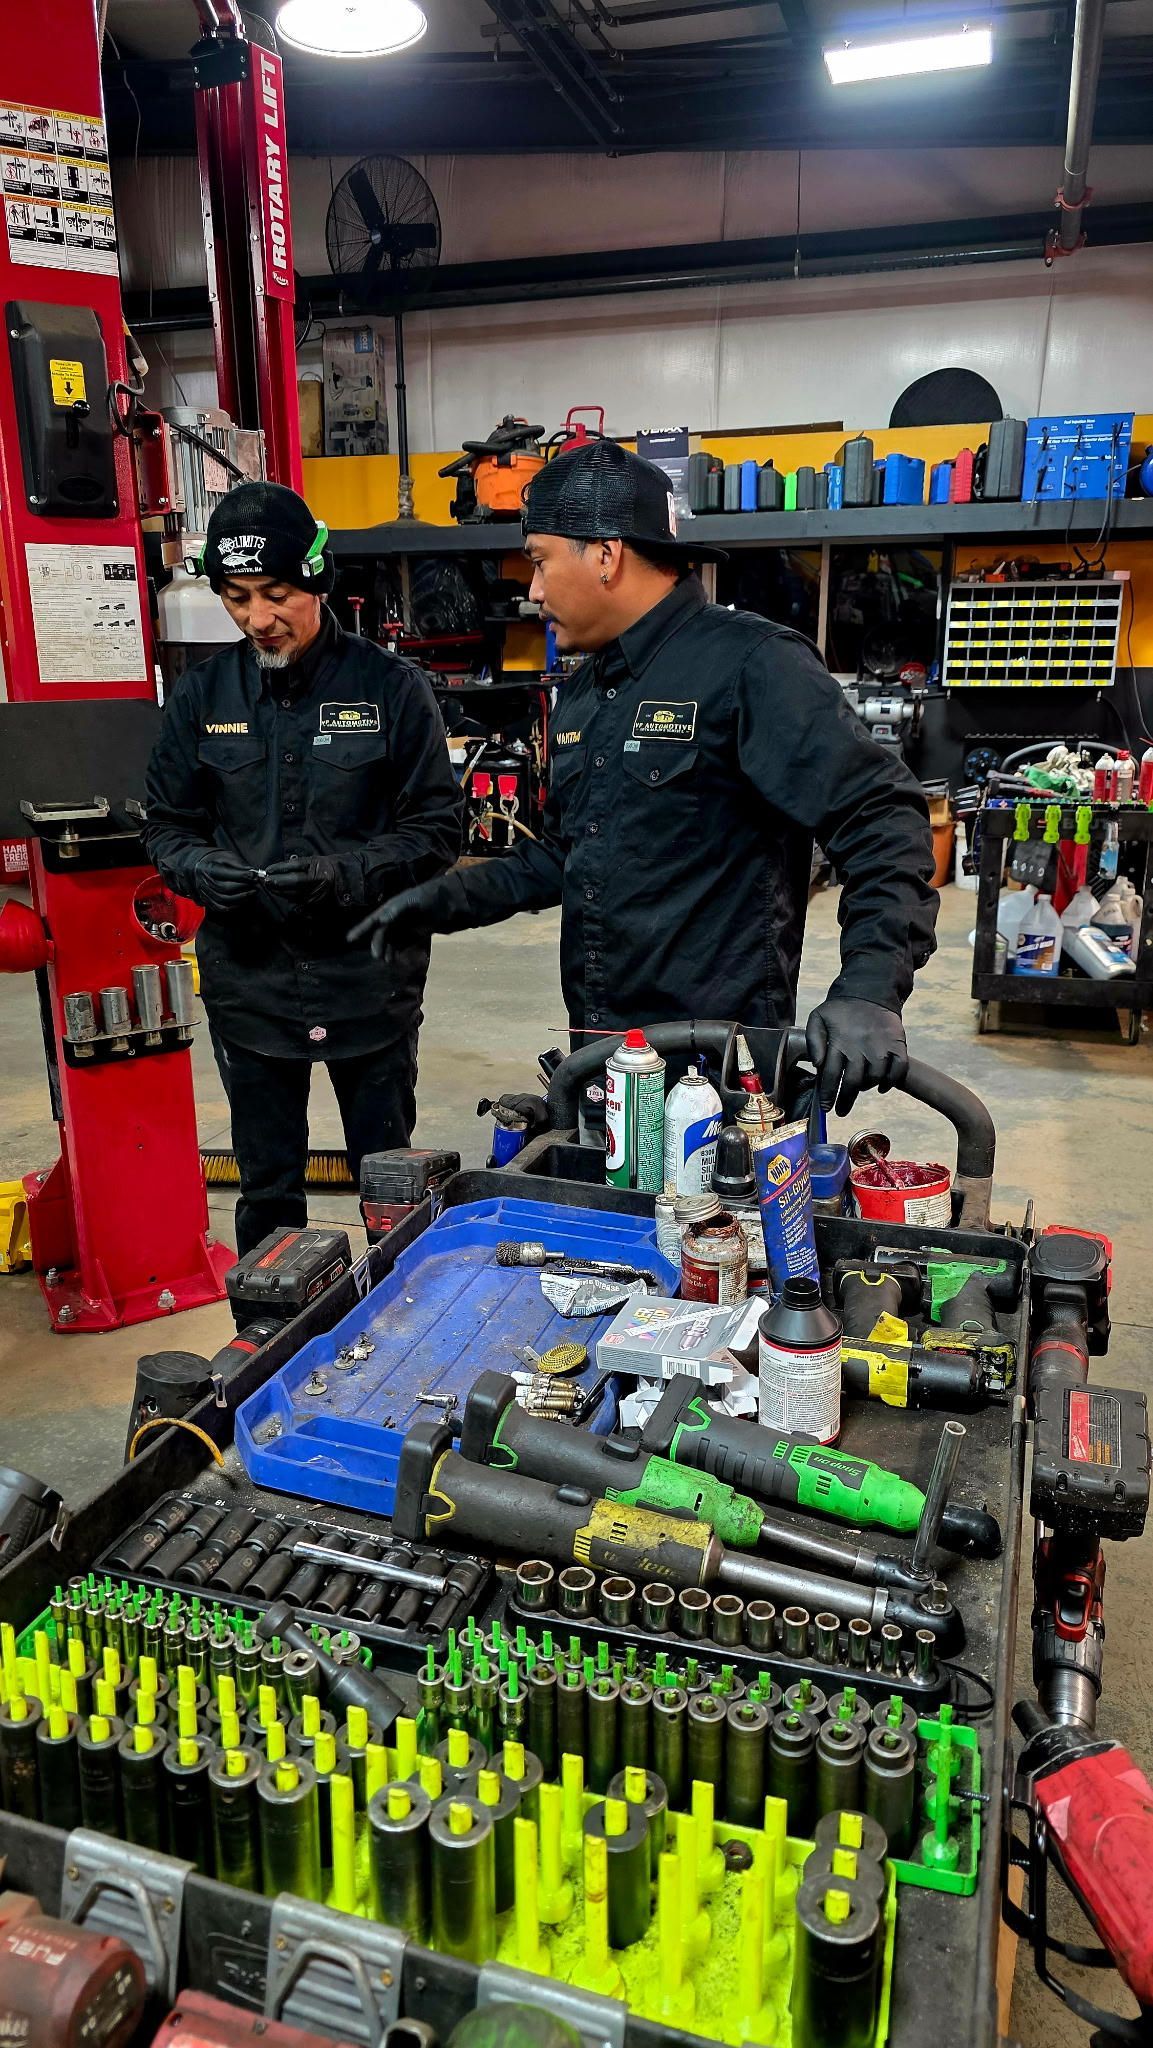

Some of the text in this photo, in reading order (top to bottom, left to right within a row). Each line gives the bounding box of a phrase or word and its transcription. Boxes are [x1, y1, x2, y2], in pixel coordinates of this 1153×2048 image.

[260, 53, 287, 270] ROTARY LIFT
[234, 535, 267, 550] LIMITS
[205, 722, 249, 734] VINNIE
[644, 722, 693, 731] AUTOMOTIVE
[770, 1159, 790, 1181] NAPA
[594, 1279, 620, 1292] Grease
[214, 1499, 226, 1507] 18
[7, 1935, 67, 1966] FUEL
